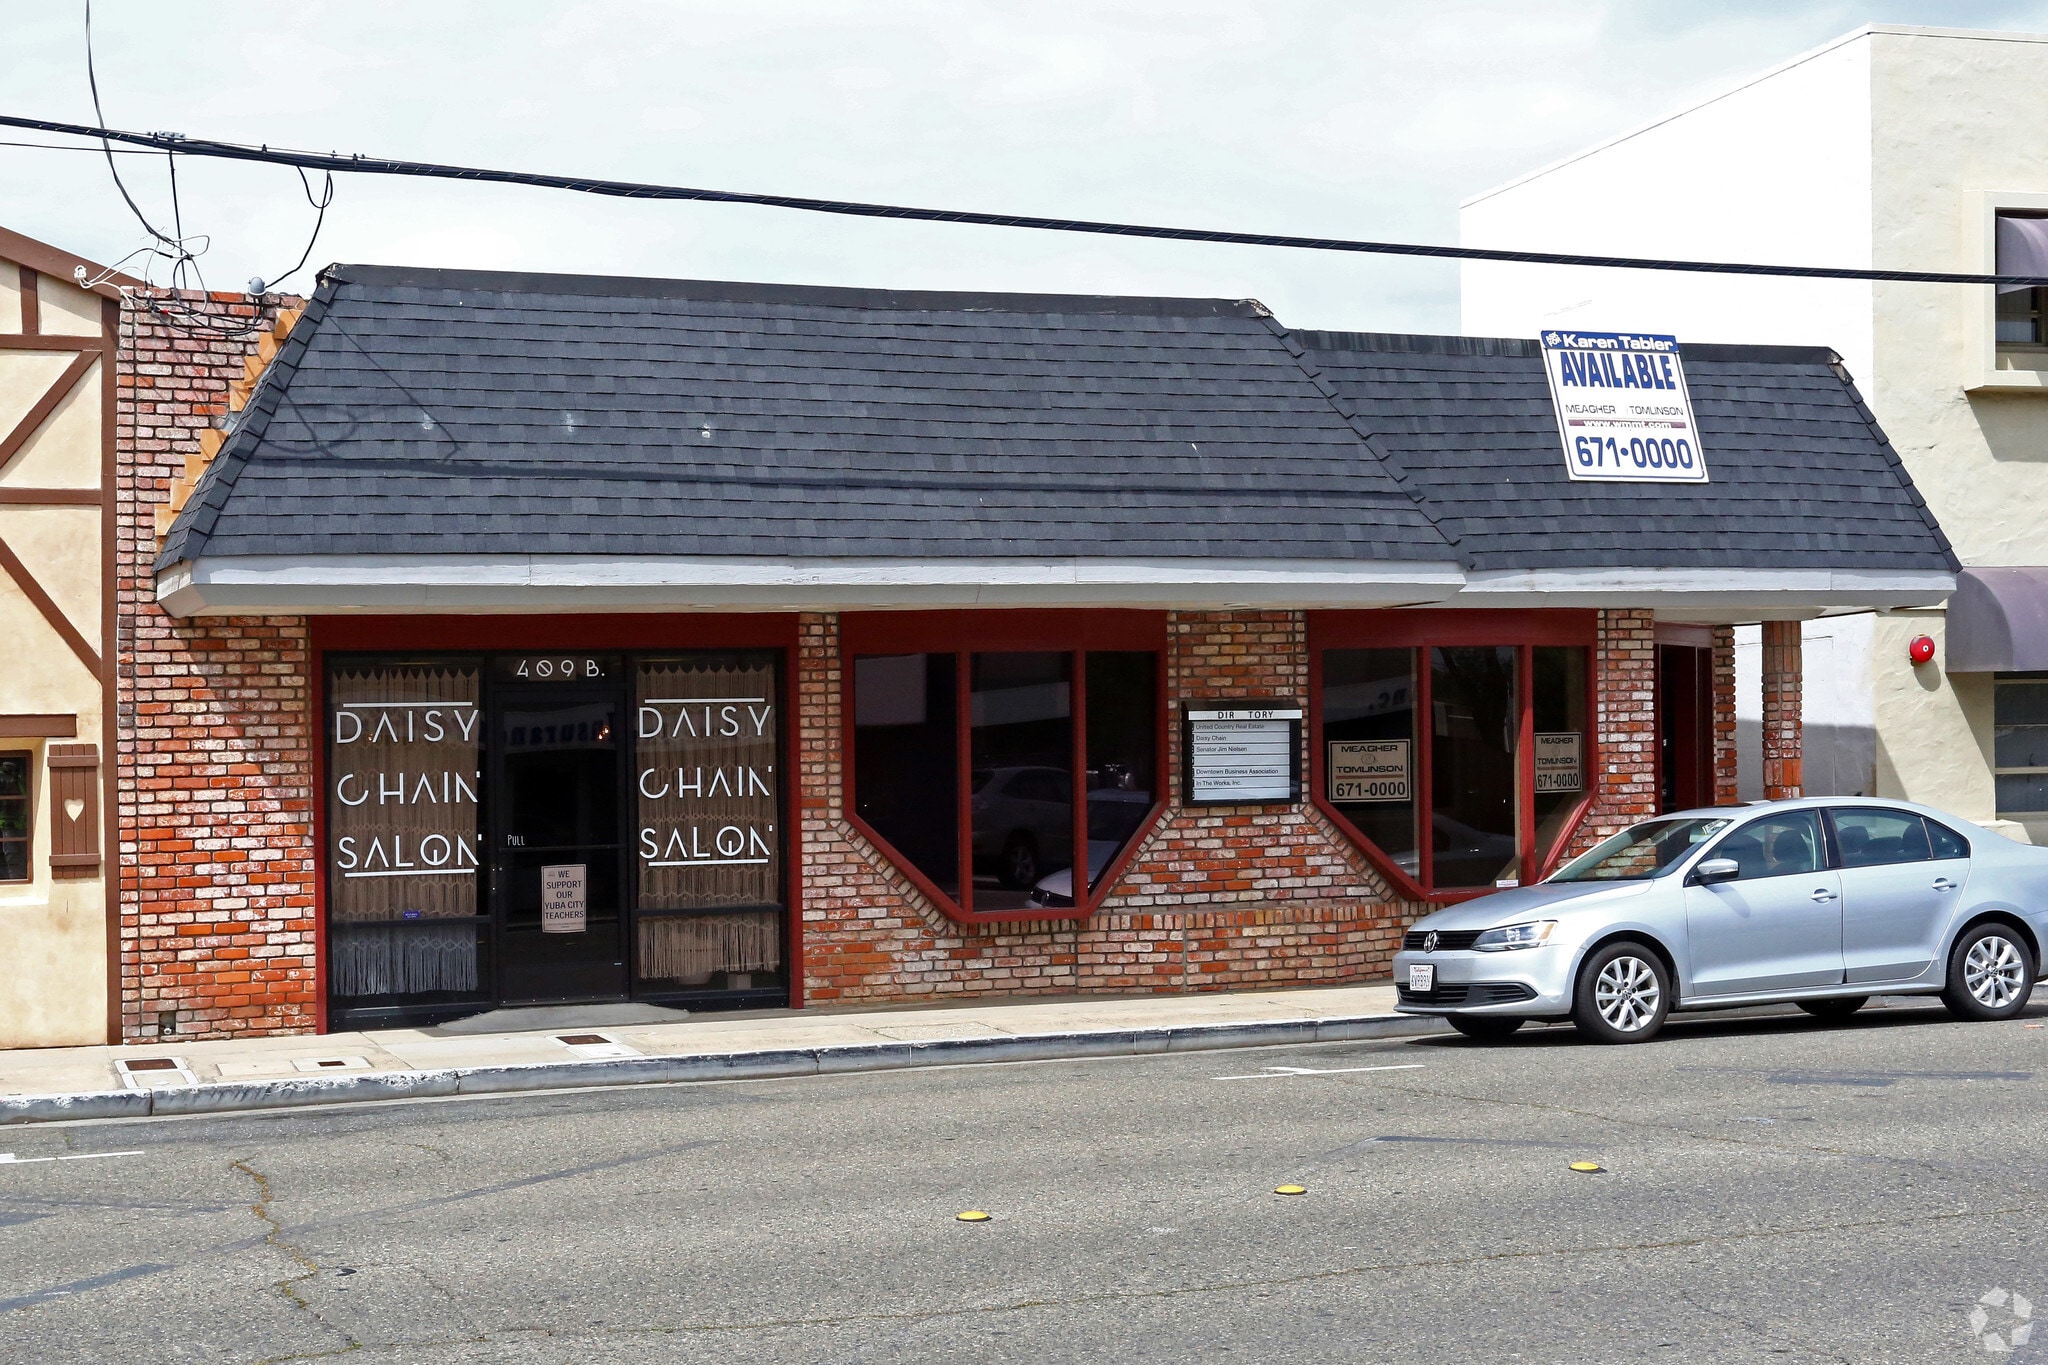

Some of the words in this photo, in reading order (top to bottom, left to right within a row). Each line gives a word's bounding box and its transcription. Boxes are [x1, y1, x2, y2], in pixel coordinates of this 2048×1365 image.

[1562, 333, 1619, 349] Karen
[1618, 335, 1674, 351] Tabler
[1560, 351, 1676, 390] AVAILABLE
[1565, 404, 1617, 414] MEAGHER
[1628, 405, 1684, 416] TOMLINSON
[516, 659, 574, 678] 409
[336, 709, 479, 744] DAISY
[638, 705, 771, 738] DAISY
[1213, 723, 1234, 731] Country
[1540, 737, 1574, 745] MEAGHER
[1341, 744, 1398, 753] MEAGHER
[1537, 757, 1577, 765] TOMLINSON
[1336, 765, 1403, 773] TOMLINSON
[639, 765, 773, 799] CHAIN
[1537, 773, 1579, 788] 671-0000
[337, 770, 481, 806] CHAIN
[1336, 781, 1406, 797] 671-0000
[507, 834, 526, 847] PULL
[639, 825, 773, 859] SALON
[337, 833, 483, 869] SALON
[557, 870, 570, 878] WE
[546, 880, 582, 889] SUPPORT
[556, 891, 573, 899] OUR
[545, 901, 566, 909] YUBA
[567, 900, 585, 909] CITY
[545, 910, 585, 920] TEACHERS
